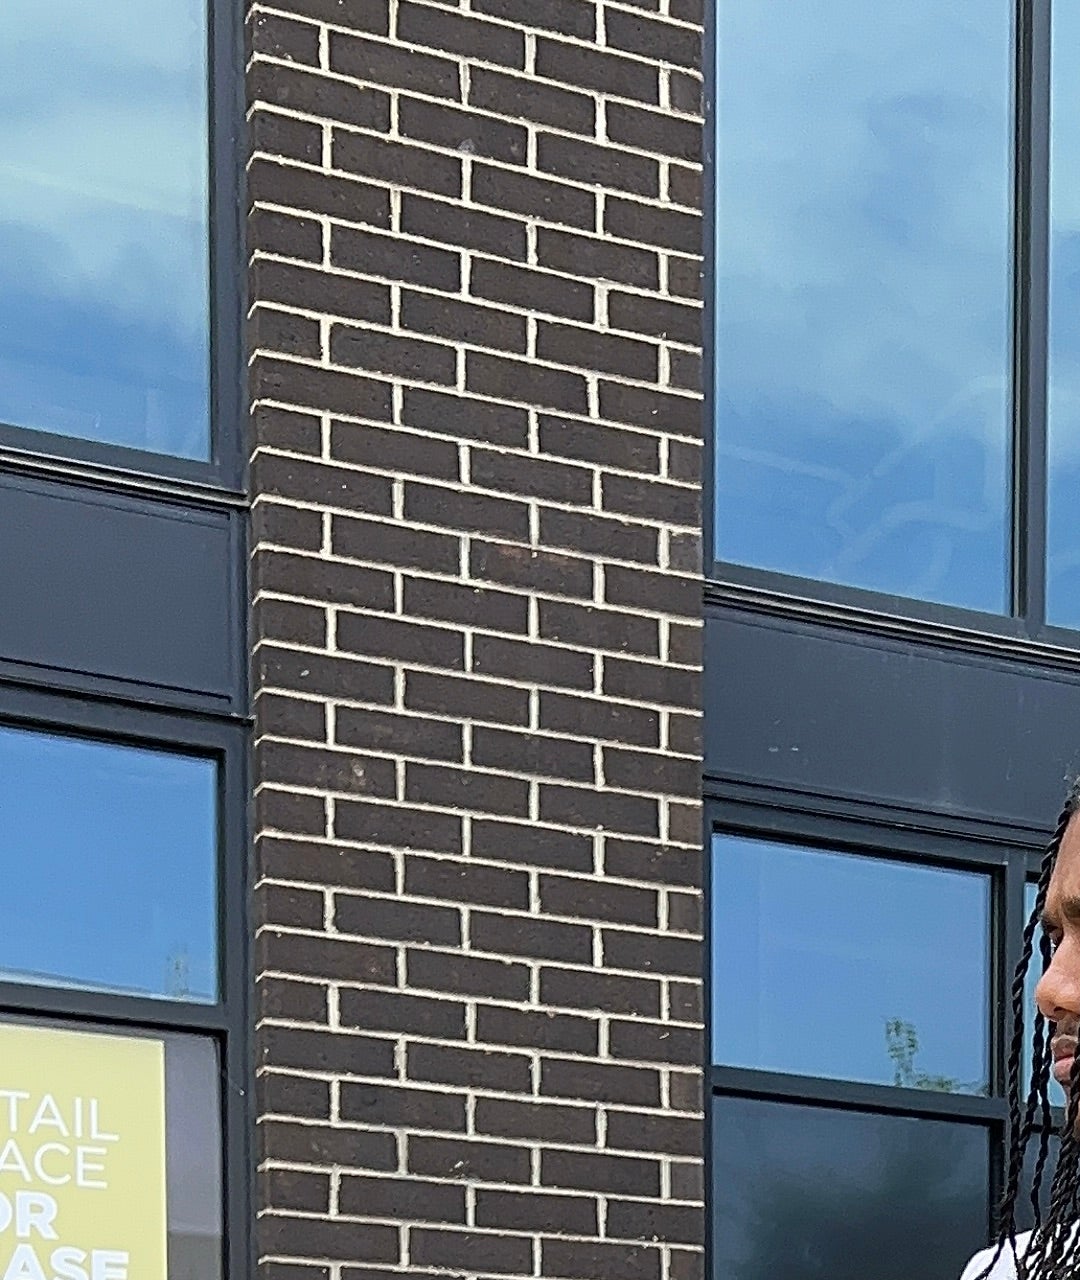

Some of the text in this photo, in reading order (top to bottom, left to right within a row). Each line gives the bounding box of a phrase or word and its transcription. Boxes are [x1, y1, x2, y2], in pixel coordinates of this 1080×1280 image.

[0, 1090, 120, 1142] TAIL
[0, 1138, 108, 1189] ACE
[0, 1190, 59, 1240] R
